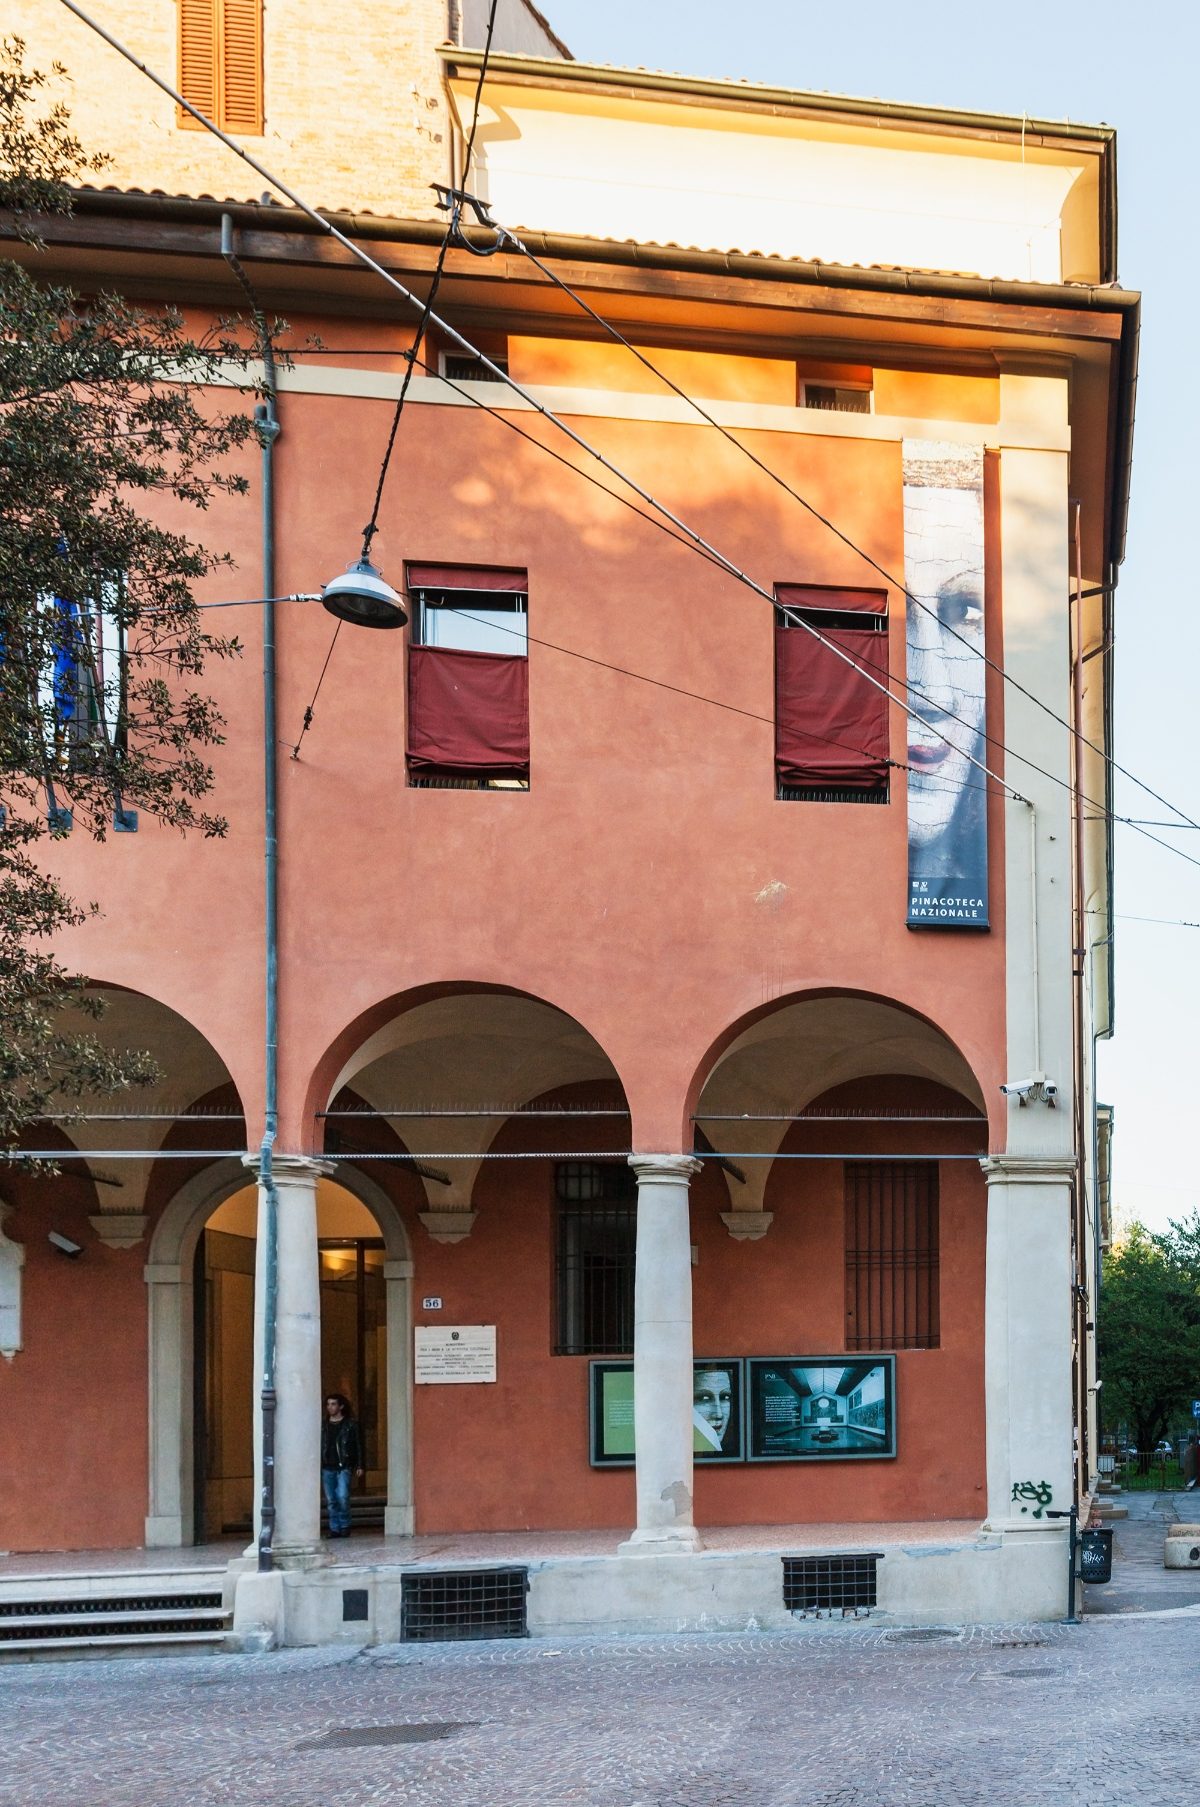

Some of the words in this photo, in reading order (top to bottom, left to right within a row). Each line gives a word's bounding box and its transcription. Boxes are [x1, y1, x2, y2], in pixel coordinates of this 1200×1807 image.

[911, 897, 984, 907] PINACOTECA
[911, 908, 978, 918] NAZIONALE
[425, 1299, 439, 1308] 56
